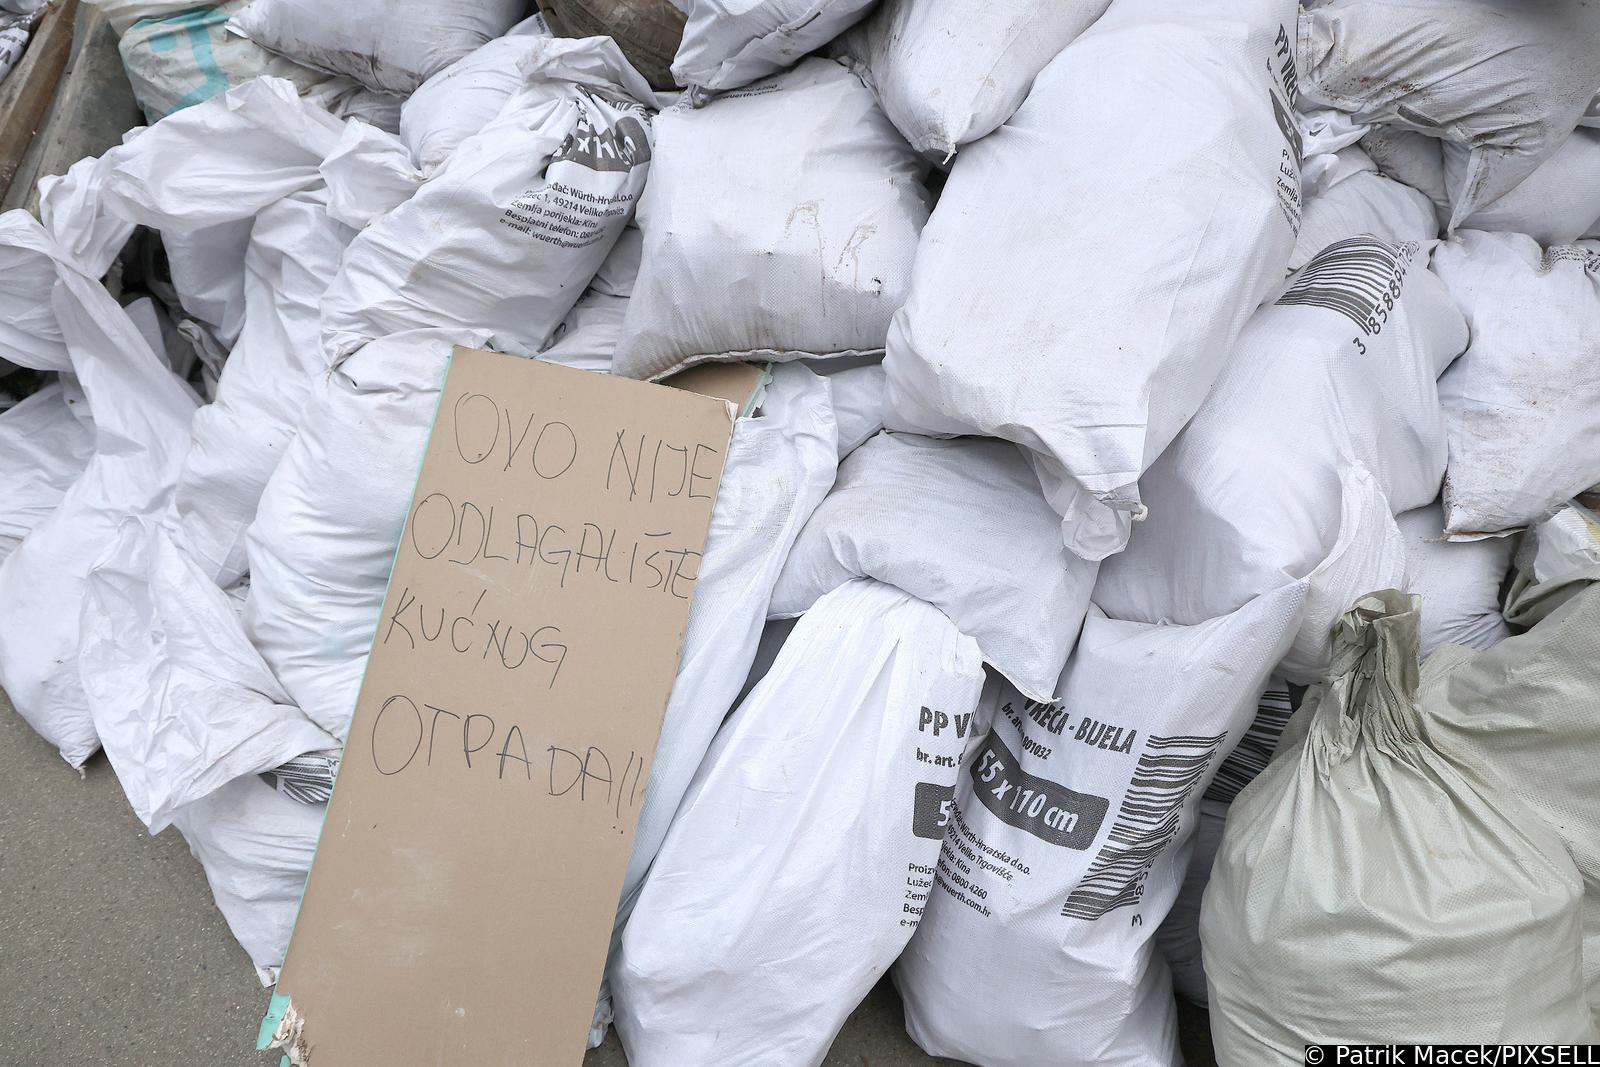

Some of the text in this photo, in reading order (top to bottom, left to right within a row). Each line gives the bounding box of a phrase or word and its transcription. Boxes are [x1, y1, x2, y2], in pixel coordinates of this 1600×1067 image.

[553, 197, 579, 212] 49214
[580, 205, 603, 218] Veliko
[549, 222, 579, 239] telefon:
[1353, 337, 1366, 355] 3
[454, 391, 718, 503] OVO NIJE
[918, 705, 949, 737] PP
[1074, 717, 1137, 754] BIJELA
[916, 747, 932, 764] br.
[934, 754, 956, 768] art.
[977, 749, 1005, 782] 55
[991, 779, 1013, 801] x
[1043, 806, 1079, 833] cm
[958, 841, 976, 862] Veliko
[960, 822, 1011, 864] Würth-Hrvatska
[1010, 858, 1031, 876] d.o.o.
[955, 858, 971, 876] Kina
[951, 872, 970, 890] 0800
[969, 883, 988, 900] 4260
